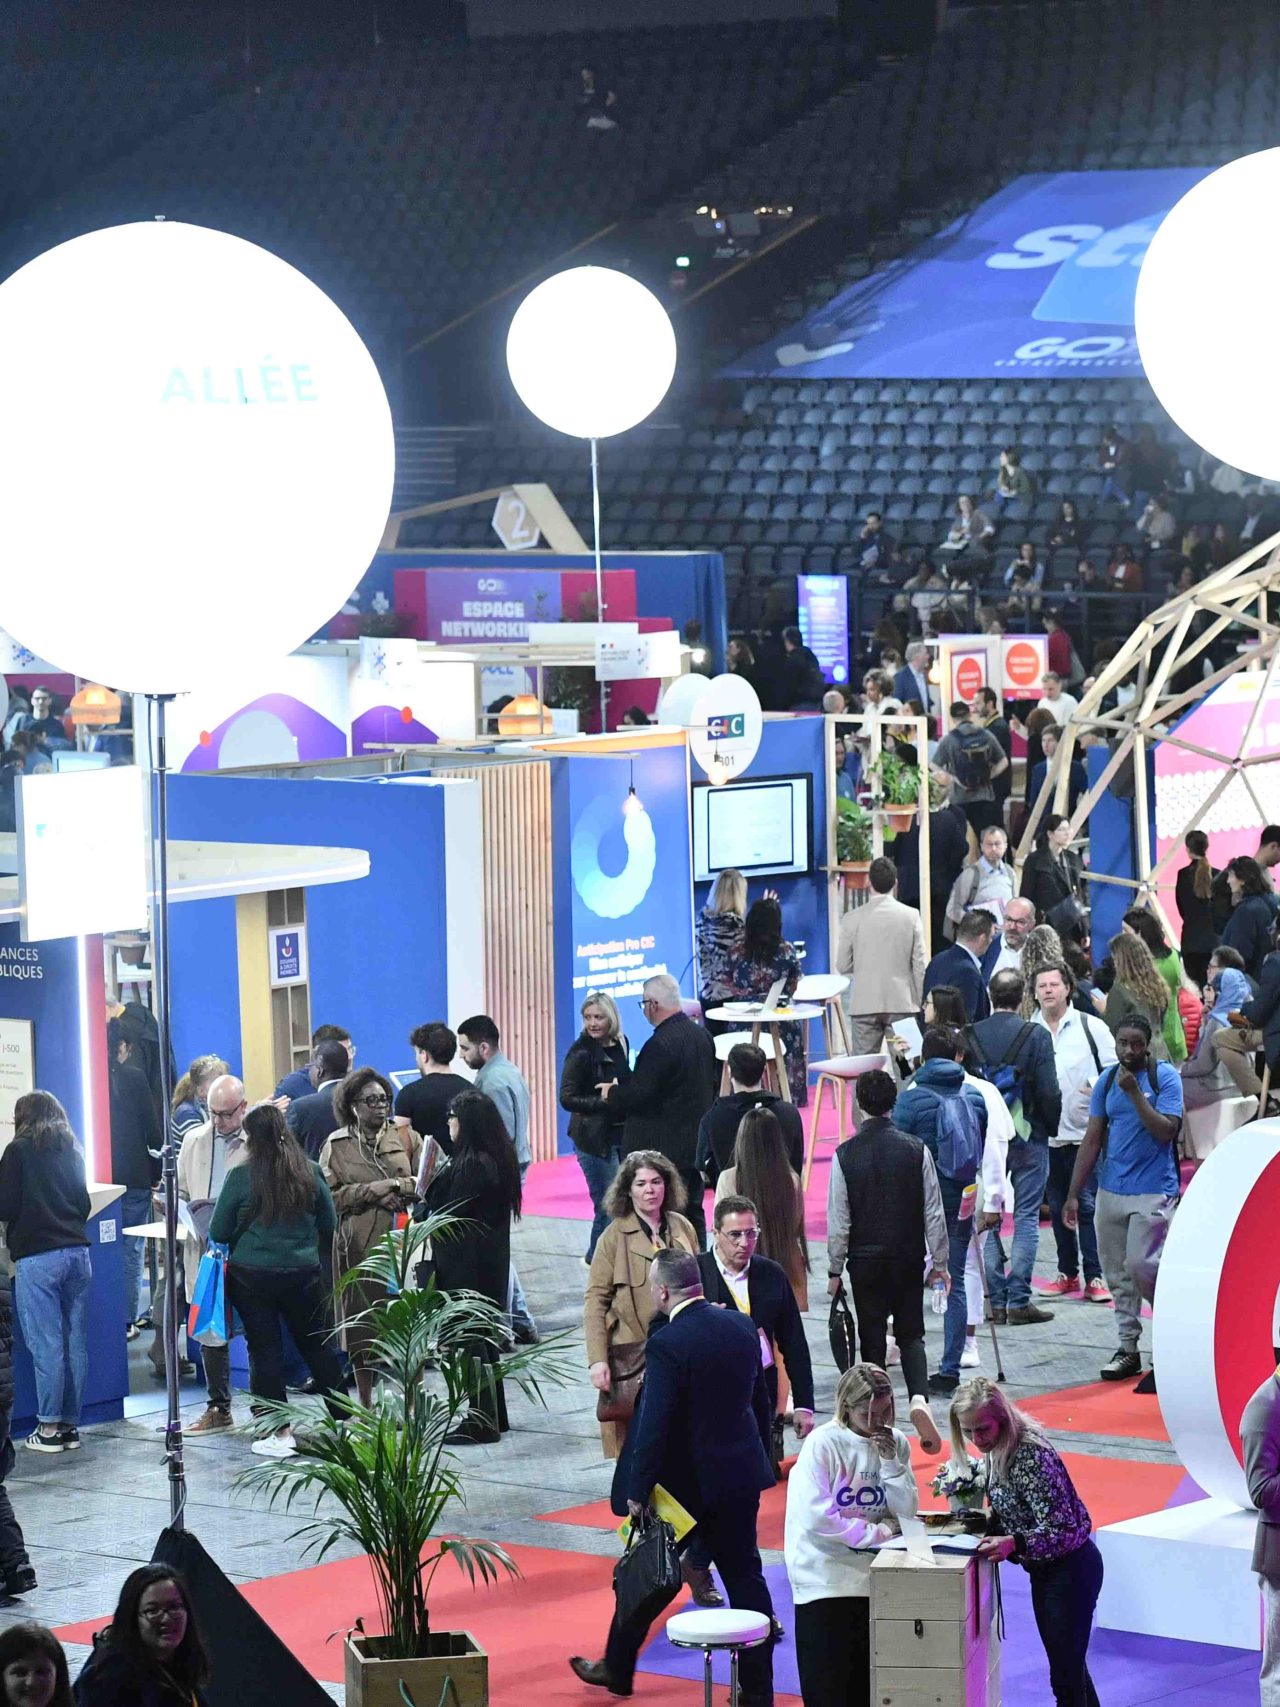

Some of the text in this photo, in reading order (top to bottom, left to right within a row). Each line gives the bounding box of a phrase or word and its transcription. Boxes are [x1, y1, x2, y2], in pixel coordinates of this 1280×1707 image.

[159, 353, 319, 405] ALLÉE
[508, 499, 529, 539] 2
[463, 601, 525, 618] ESPACE
